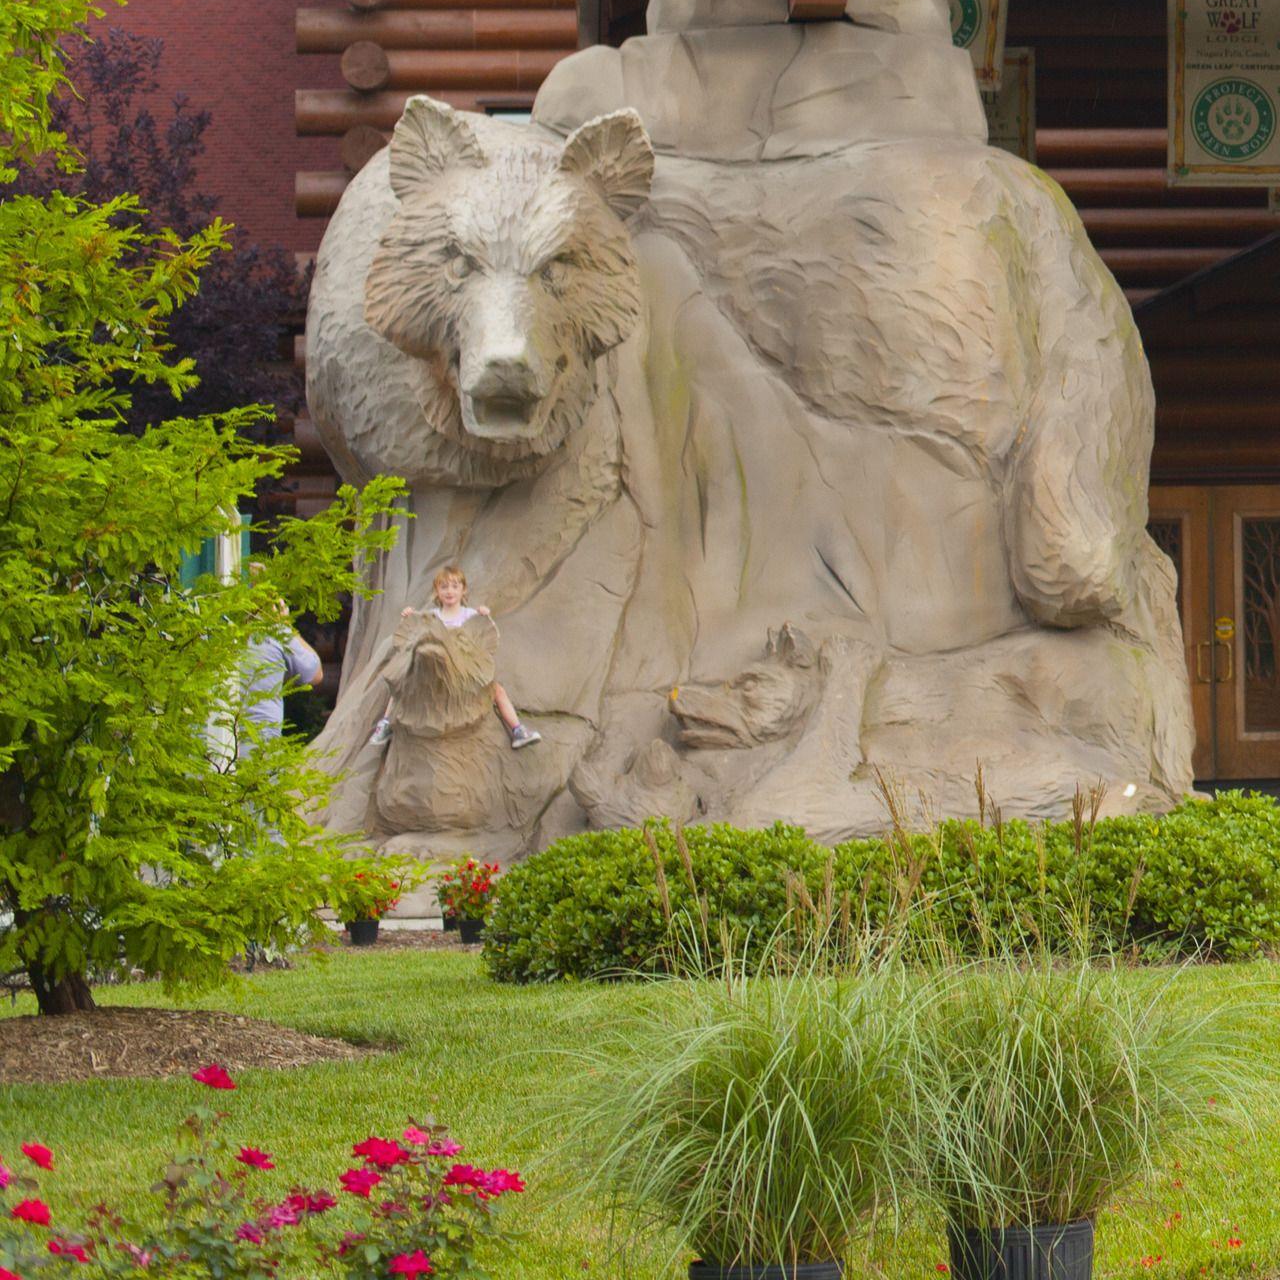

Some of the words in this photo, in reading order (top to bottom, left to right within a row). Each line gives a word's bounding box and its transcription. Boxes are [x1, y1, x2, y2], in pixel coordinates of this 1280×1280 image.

[1206, 35, 1262, 43] LODGE
[1205, 82, 1263, 104] PROJECT
[1197, 121, 1231, 155] GREEN
[1240, 125, 1270, 155] WOLF
